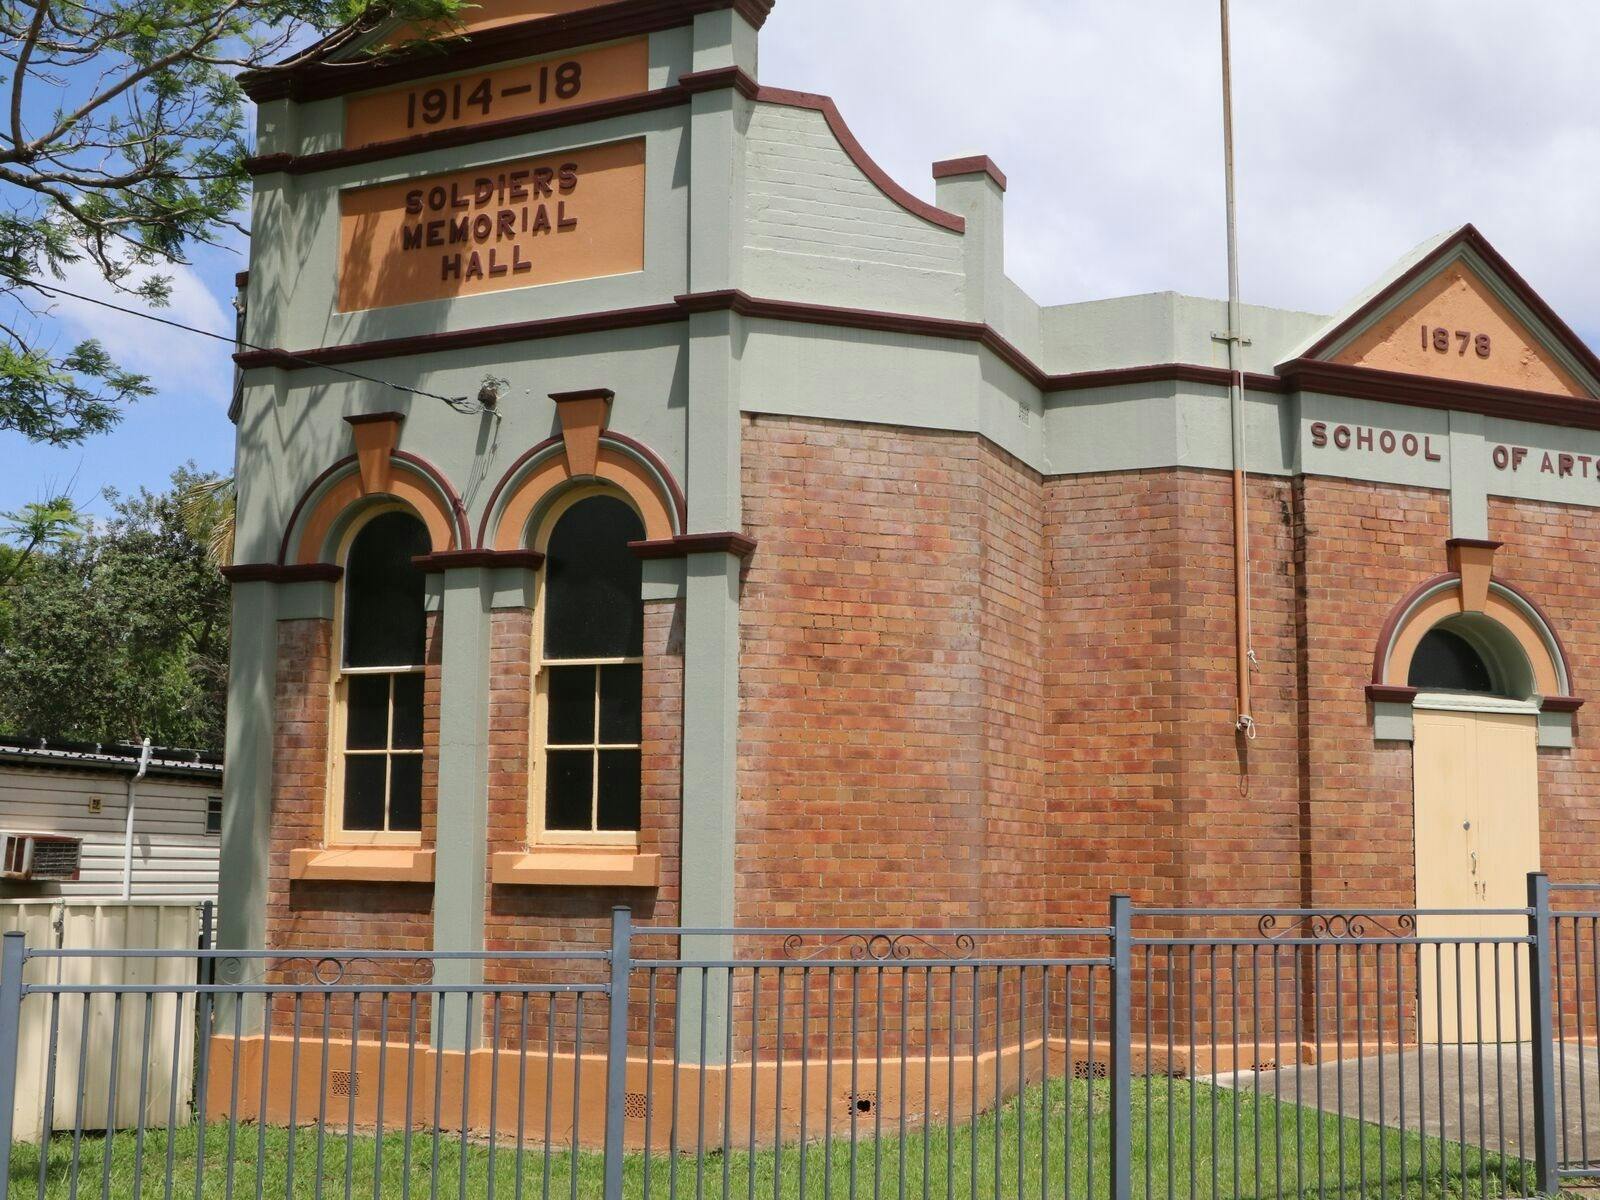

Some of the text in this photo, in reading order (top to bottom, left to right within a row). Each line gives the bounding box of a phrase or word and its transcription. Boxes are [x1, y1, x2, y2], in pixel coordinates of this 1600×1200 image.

[407, 61, 582, 128] 1914-18
[405, 163, 578, 214] SOLDIERS
[402, 201, 578, 250] MEMORIAL
[441, 245, 532, 281] HALL
[1421, 325, 1491, 359] 1878
[1310, 422, 1441, 462] SCHOOL
[1492, 445, 1528, 471] OF
